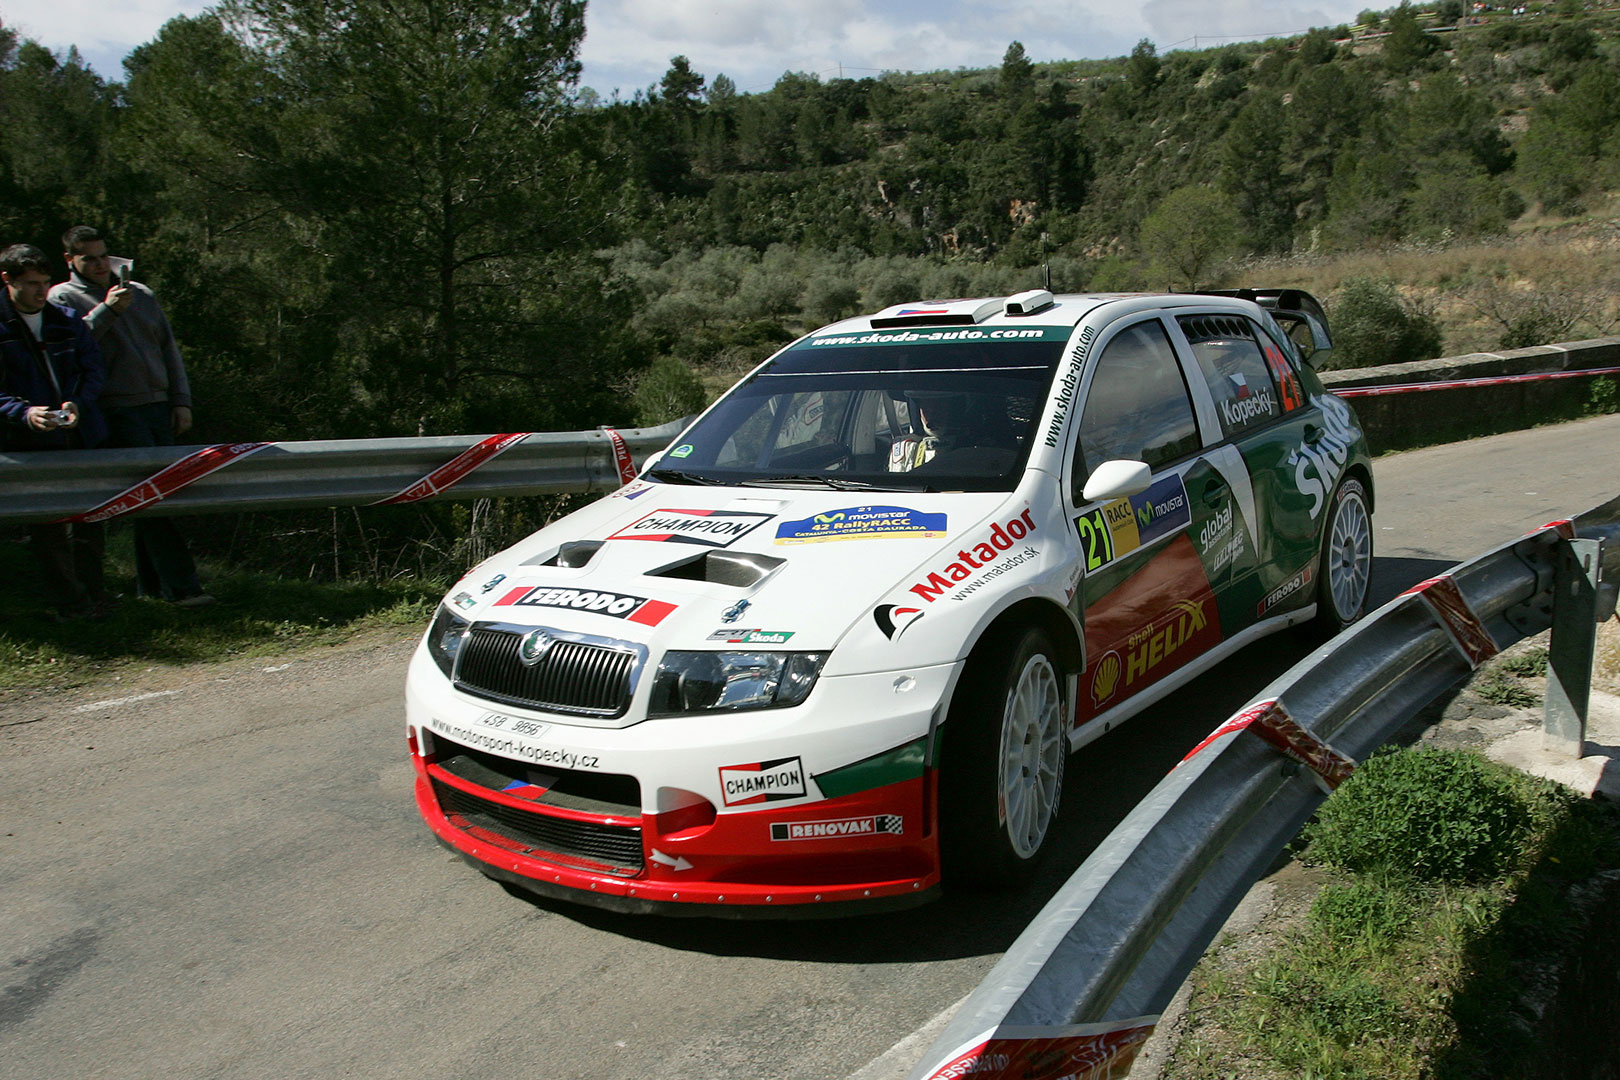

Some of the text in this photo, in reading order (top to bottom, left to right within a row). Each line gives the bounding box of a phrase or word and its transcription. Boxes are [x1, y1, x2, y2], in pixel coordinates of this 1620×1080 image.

[811, 329, 1044, 346] www.skoda-auto.com
[1045, 325, 1095, 448] www.skoda-auto.com
[1265, 344, 1302, 412] 21
[1220, 387, 1274, 425] Kopecký
[848, 511, 911, 521] movistar
[1106, 502, 1132, 524] RACC
[1154, 494, 1184, 518] movistar
[633, 518, 751, 536] CHAMPION
[811, 518, 912, 531] 42 RallyRACC
[1200, 500, 1232, 555] global
[1078, 510, 1112, 571] 21
[908, 507, 1037, 603] Matador
[951, 546, 1041, 601] www.matador.sk
[522, 588, 637, 615] FERODO
[1267, 577, 1301, 607] FERODO
[1126, 600, 1208, 687] HELIX
[1128, 623, 1154, 650] Shell
[511, 719, 543, 736] 9856
[432, 717, 600, 769] www.motorsport-kopecky.cz
[726, 770, 800, 795] CHAMPION
[792, 819, 872, 837] RENOVAK
